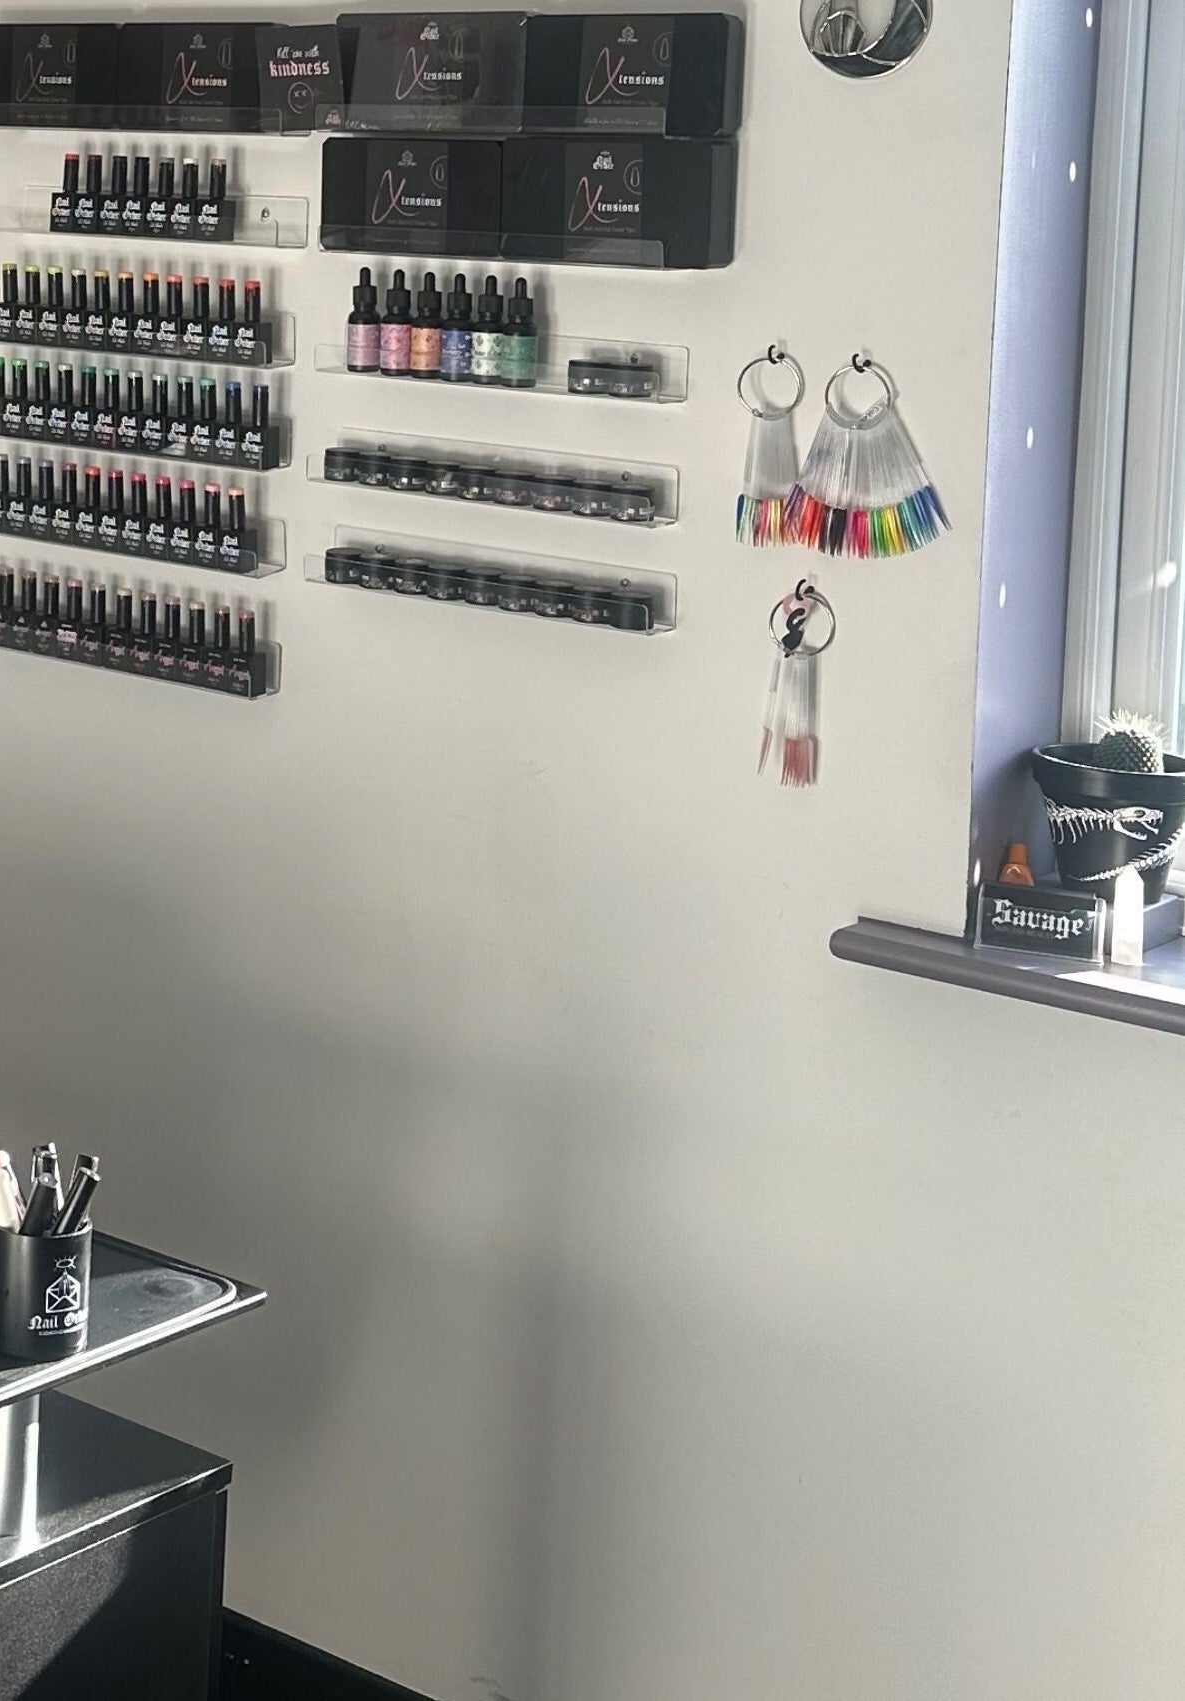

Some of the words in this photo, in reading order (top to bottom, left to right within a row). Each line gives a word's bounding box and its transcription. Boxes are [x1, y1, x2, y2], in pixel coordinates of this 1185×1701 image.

[269, 60, 330, 77] kindness
[991, 898, 1085, 940] Savage
[28, 1315, 58, 1330] Nail
